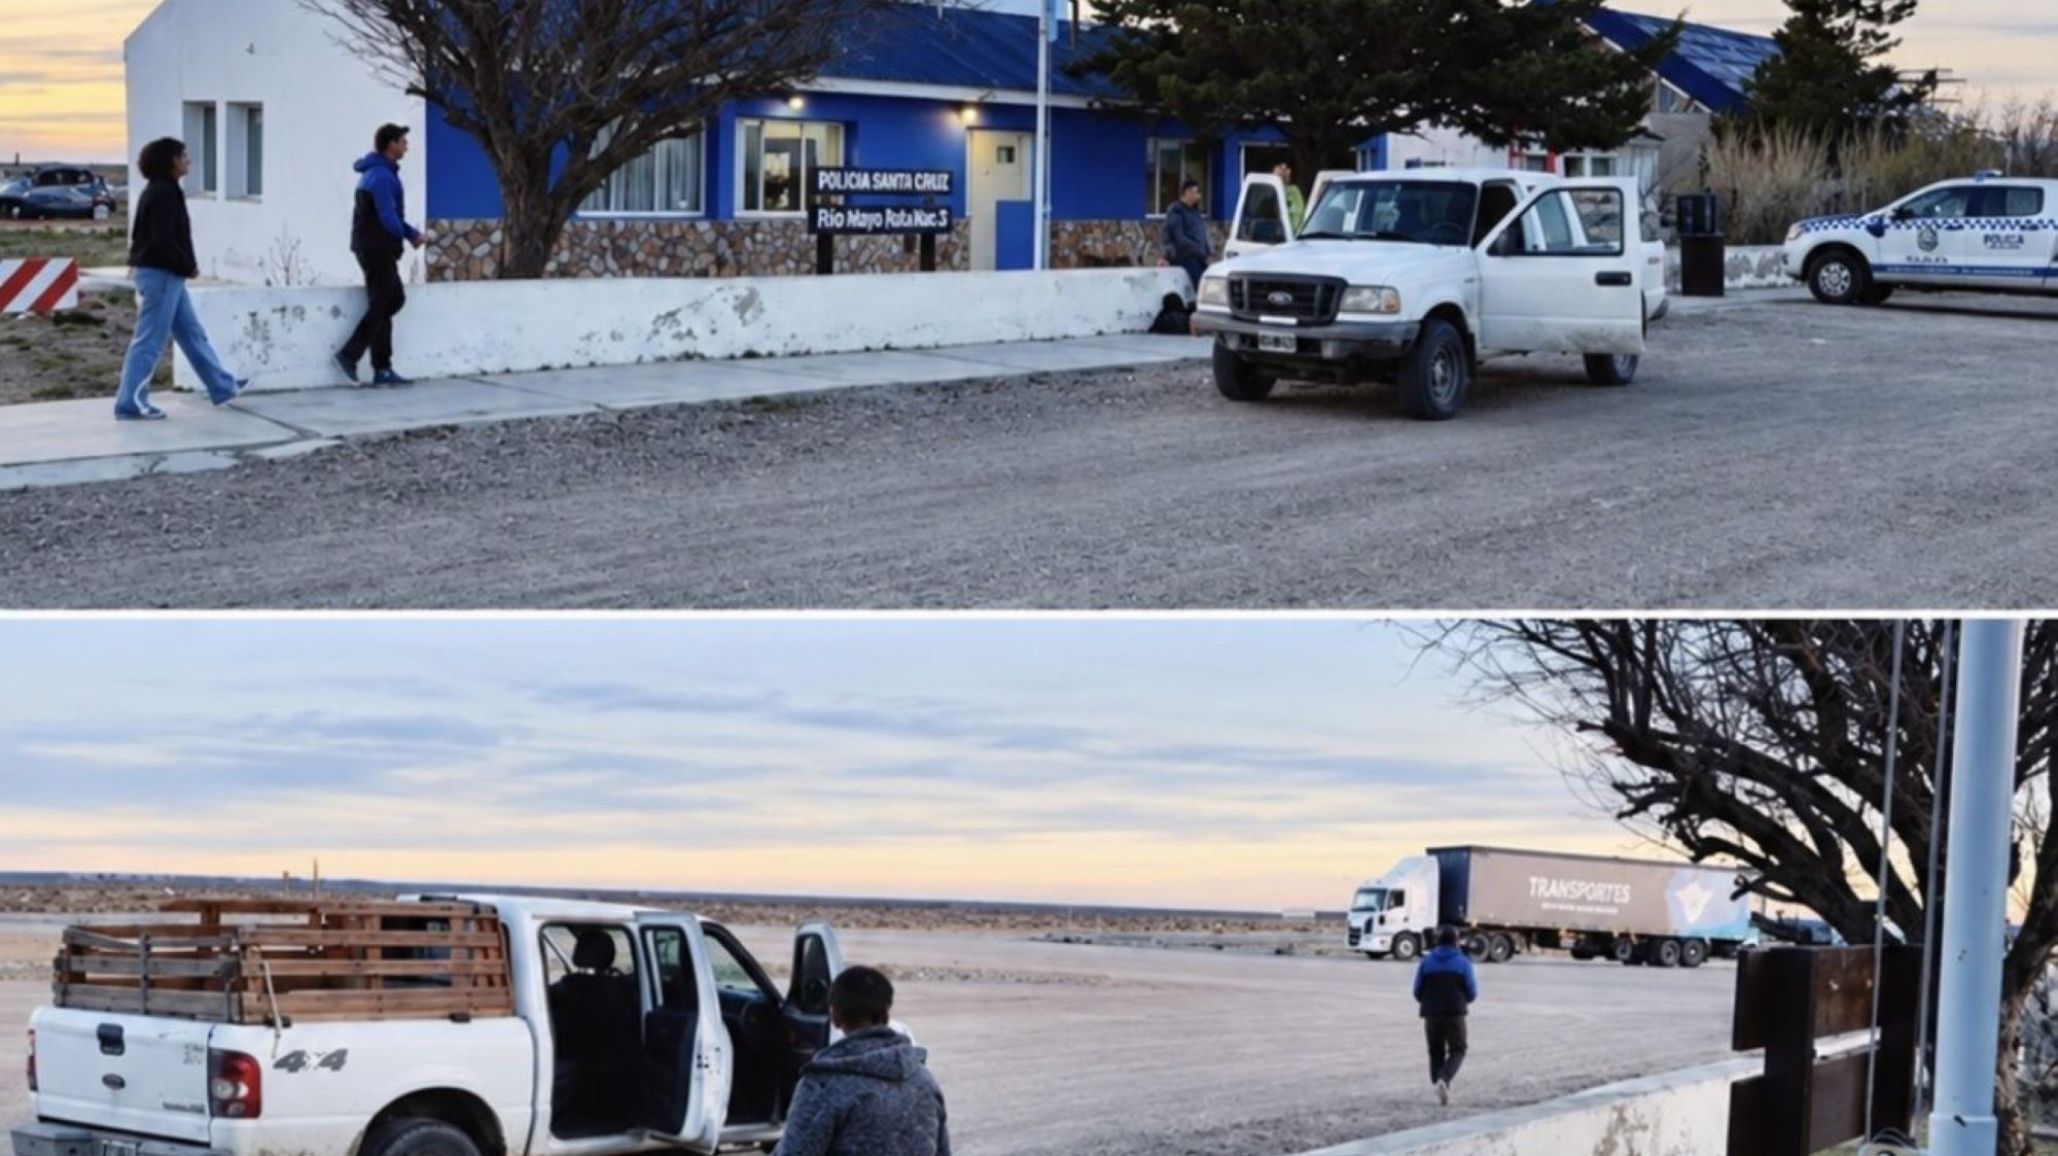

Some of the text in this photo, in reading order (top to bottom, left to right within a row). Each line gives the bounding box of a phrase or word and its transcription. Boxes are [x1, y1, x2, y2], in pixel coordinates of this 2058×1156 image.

[818, 170, 950, 191] POLICIA SANTA CRUZ
[1529, 875, 1631, 904] TRANSPORTES
